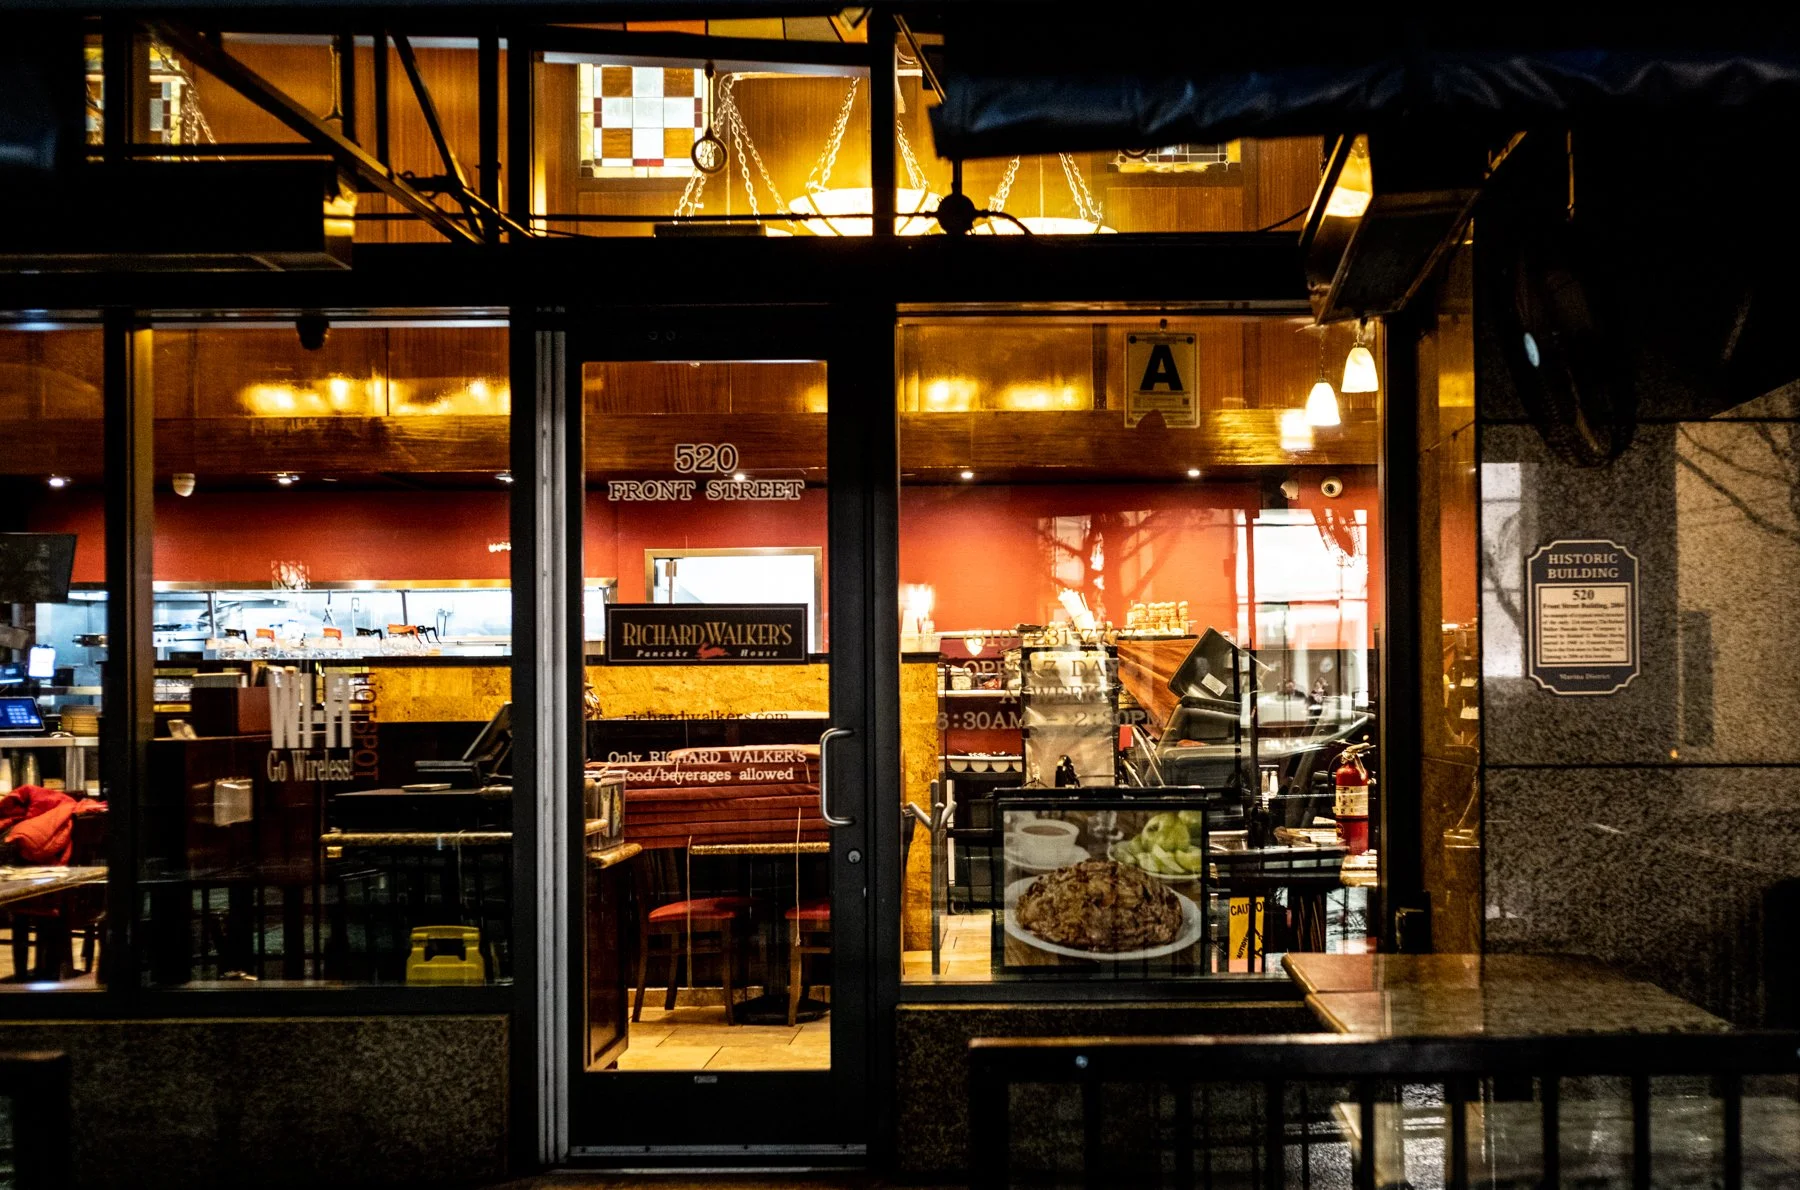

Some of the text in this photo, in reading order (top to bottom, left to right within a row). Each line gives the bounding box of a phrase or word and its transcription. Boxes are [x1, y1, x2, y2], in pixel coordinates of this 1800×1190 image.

[1139, 343, 1183, 391] A
[674, 443, 738, 473] 520
[608, 480, 804, 501] FRONT STREET
[1548, 553, 1618, 565] HISTORIC
[1547, 567, 1619, 579] BUILDING
[1572, 590, 1595, 600] 520
[637, 649, 778, 657] Pancake House
[963, 660, 1030, 678] OPEN
[1000, 686, 1017, 704] A
[608, 750, 806, 764] Only RICHARD WALKER'S
[267, 749, 354, 782] Go Wireless!
[622, 767, 794, 782] food/beverages allowed
